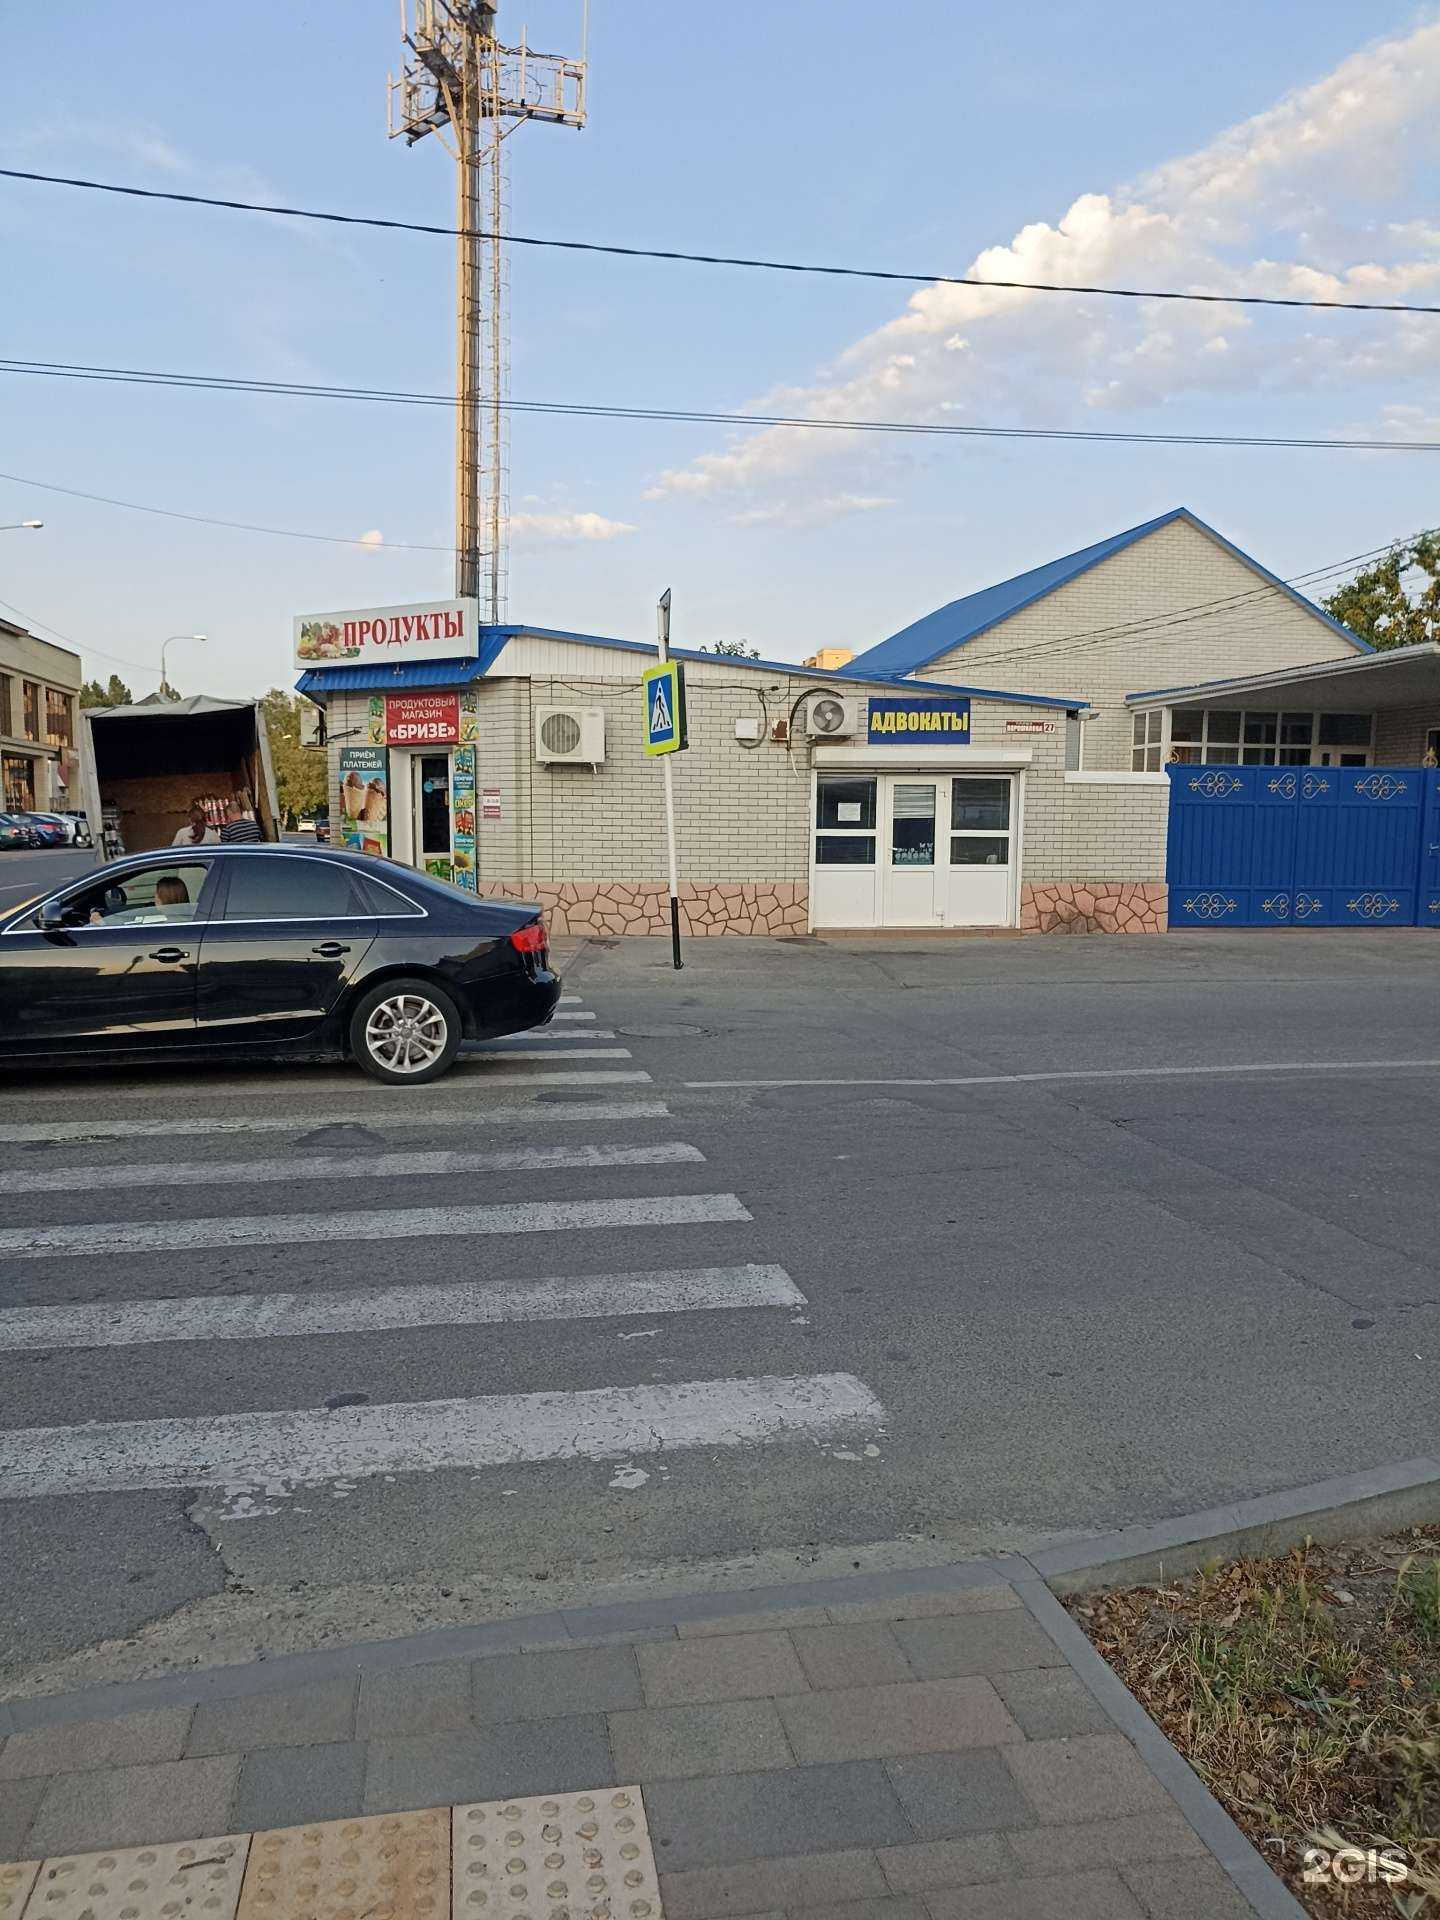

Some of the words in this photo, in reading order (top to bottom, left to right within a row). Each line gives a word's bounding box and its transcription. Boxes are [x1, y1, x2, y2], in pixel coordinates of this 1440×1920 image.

[343, 610, 464, 648] ПРОДУКТЫ
[389, 695, 456, 710] ПРОДУКТОВЫЙ
[401, 709, 443, 720] МАГАЗИН
[870, 711, 968, 734] АДВОКАТЫ
[1044, 723, 1054, 732] 27
[389, 722, 456, 739] «БРИЗЕ»
[349, 750, 376, 759] ПРИЁМ
[343, 759, 383, 769] ПЛАТЕЖЕЙ
